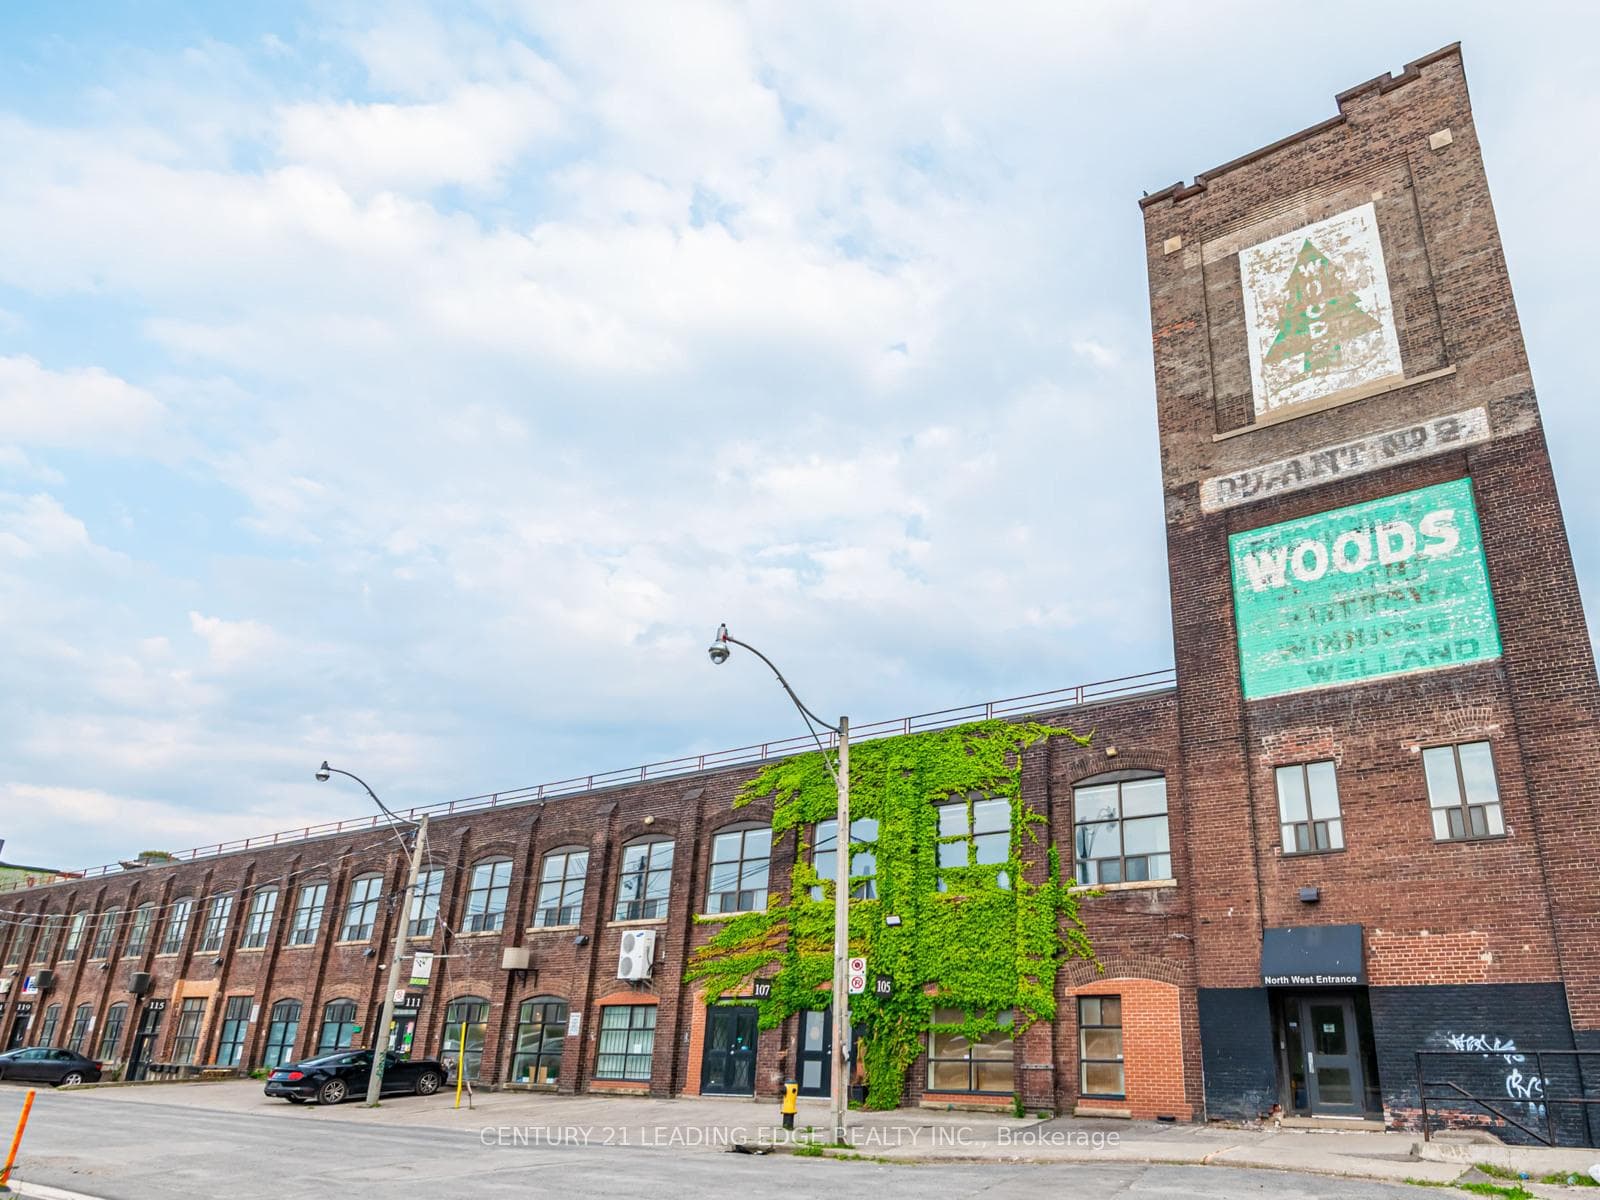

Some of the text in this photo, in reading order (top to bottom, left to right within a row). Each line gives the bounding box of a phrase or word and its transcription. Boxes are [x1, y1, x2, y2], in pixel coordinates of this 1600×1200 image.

[1243, 509, 1460, 592] WOODS
[1307, 638, 1480, 683] WELLAND
[876, 979, 891, 993] 105
[1264, 975, 1357, 985] North West Entrance
[754, 983, 770, 996] 107
[16, 1003, 31, 1011] 119
[149, 1001, 165, 1010] 115
